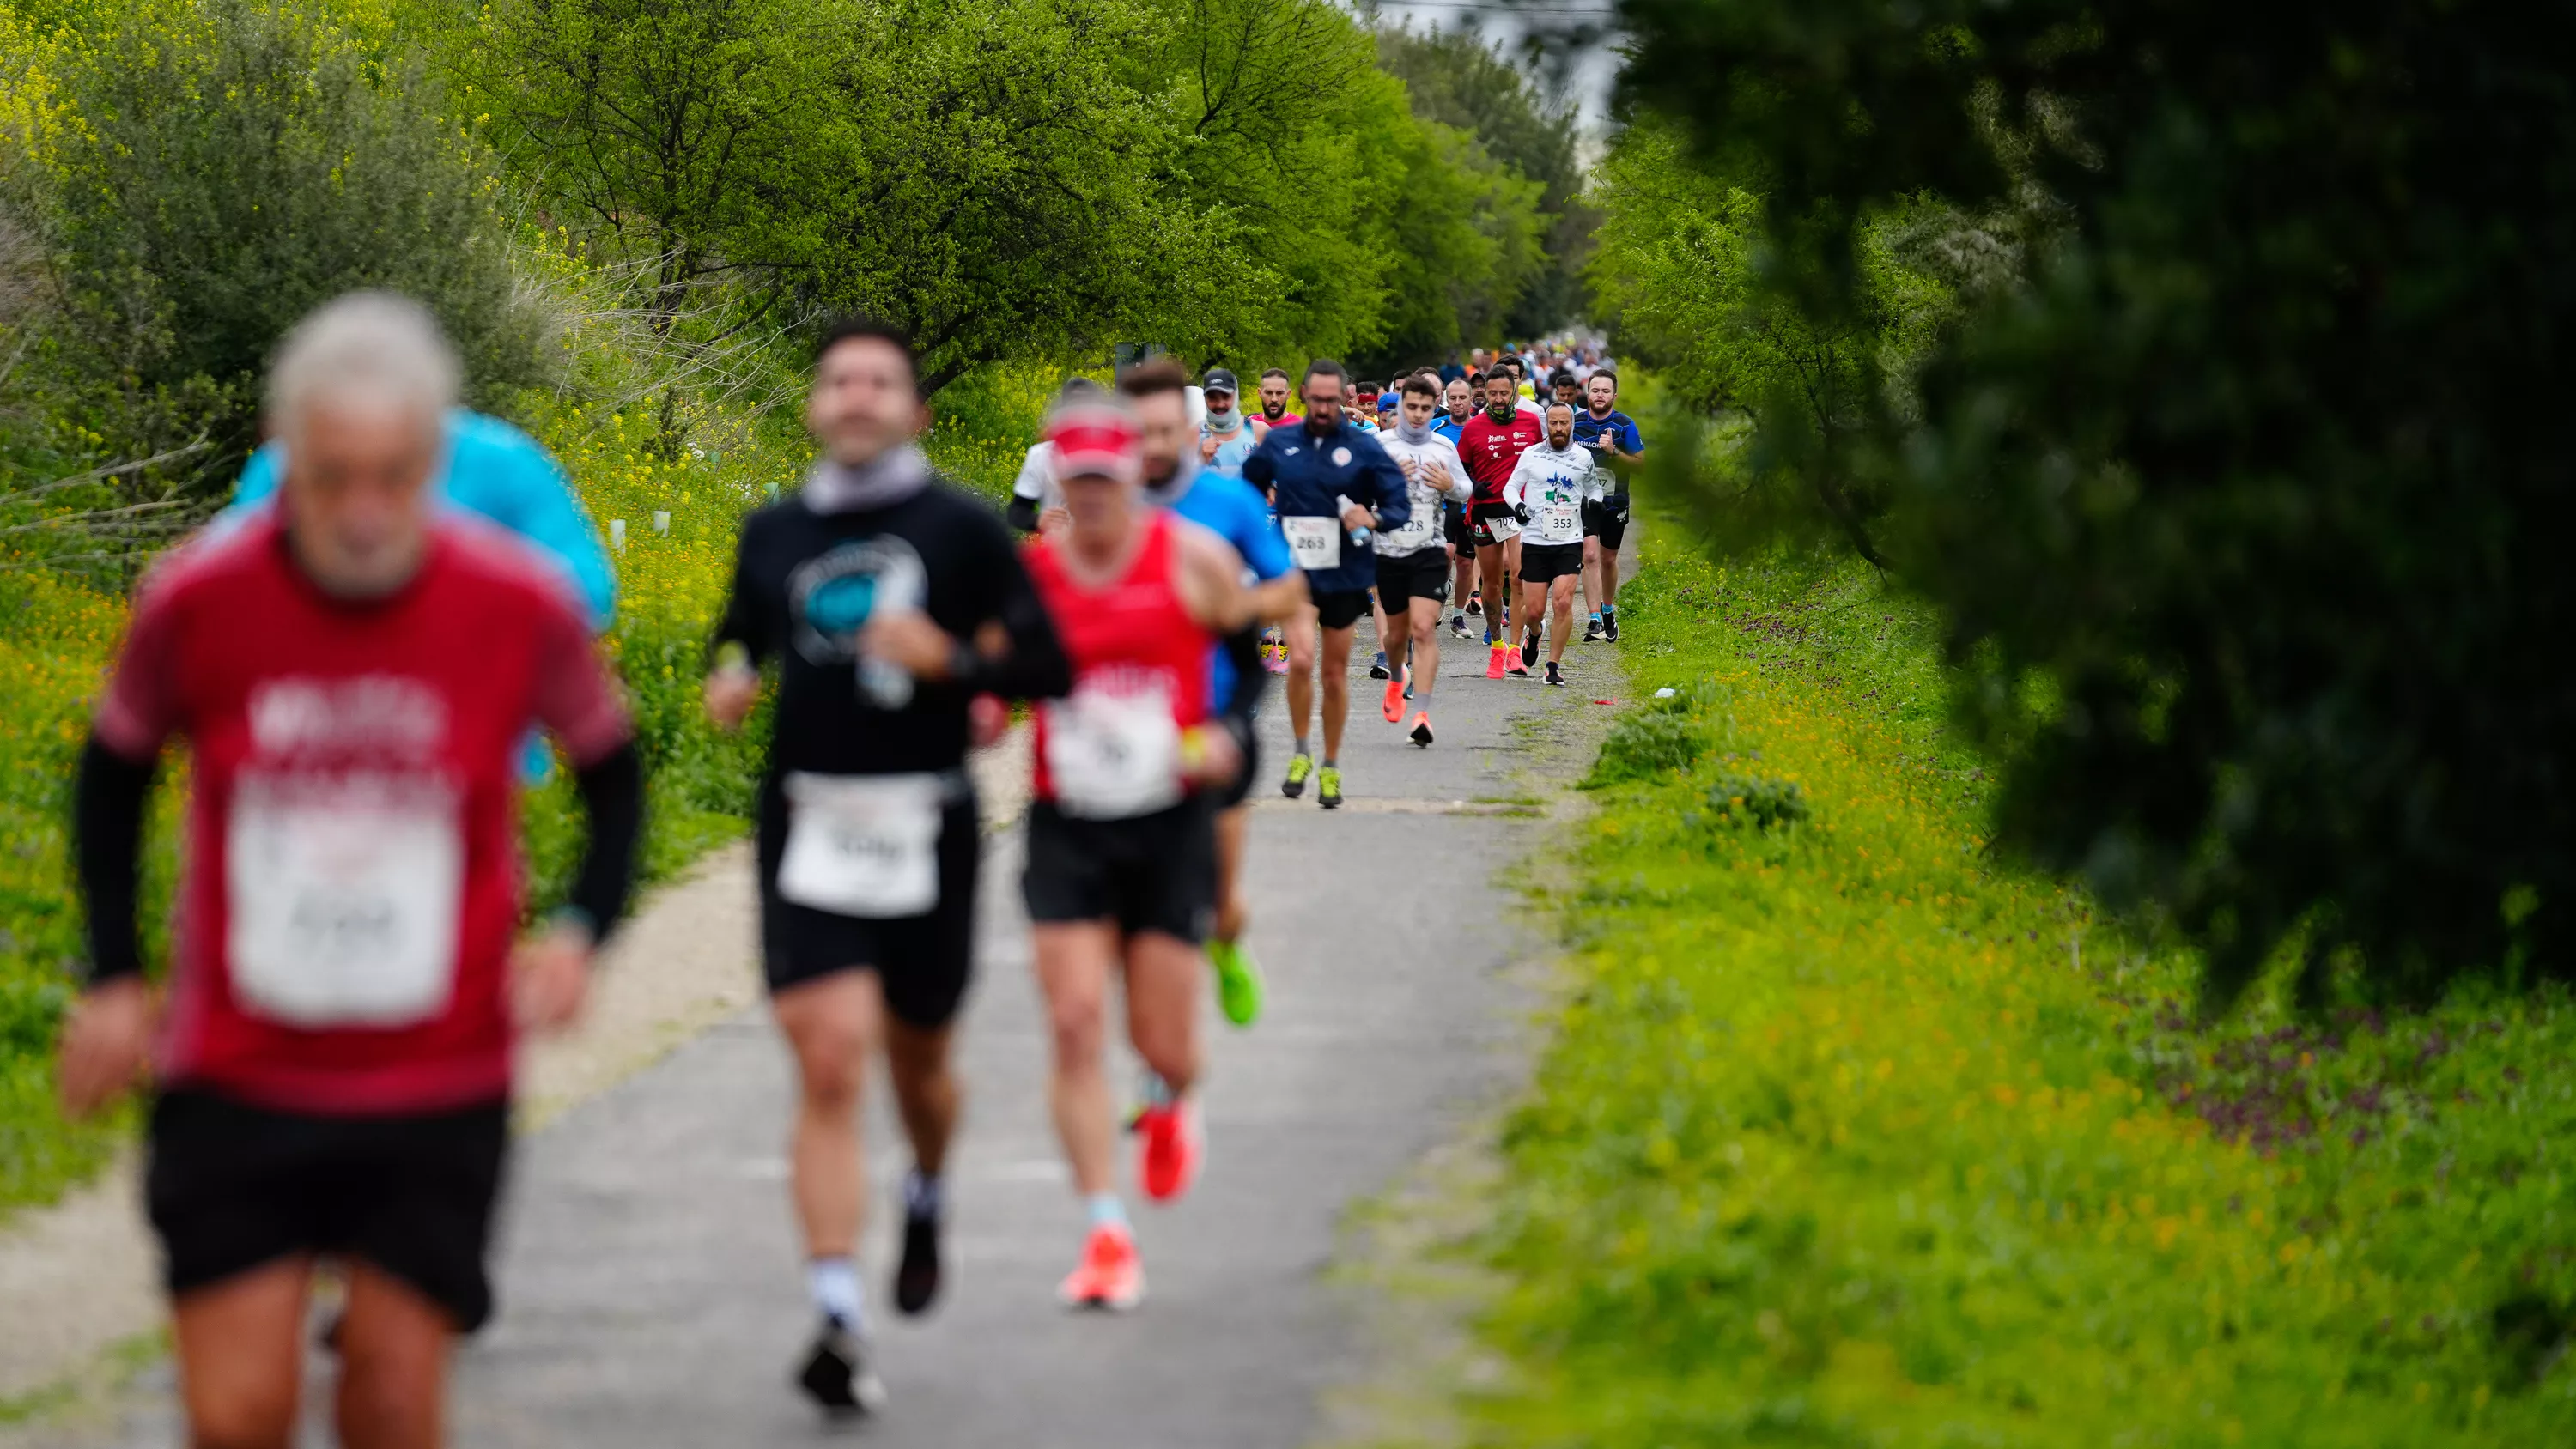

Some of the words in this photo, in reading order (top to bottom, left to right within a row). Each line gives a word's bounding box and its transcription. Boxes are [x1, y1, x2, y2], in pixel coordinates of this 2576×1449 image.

[1496, 517, 1515, 528] 702
[1553, 518, 1571, 529] 353
[1297, 536, 1326, 550] 263
